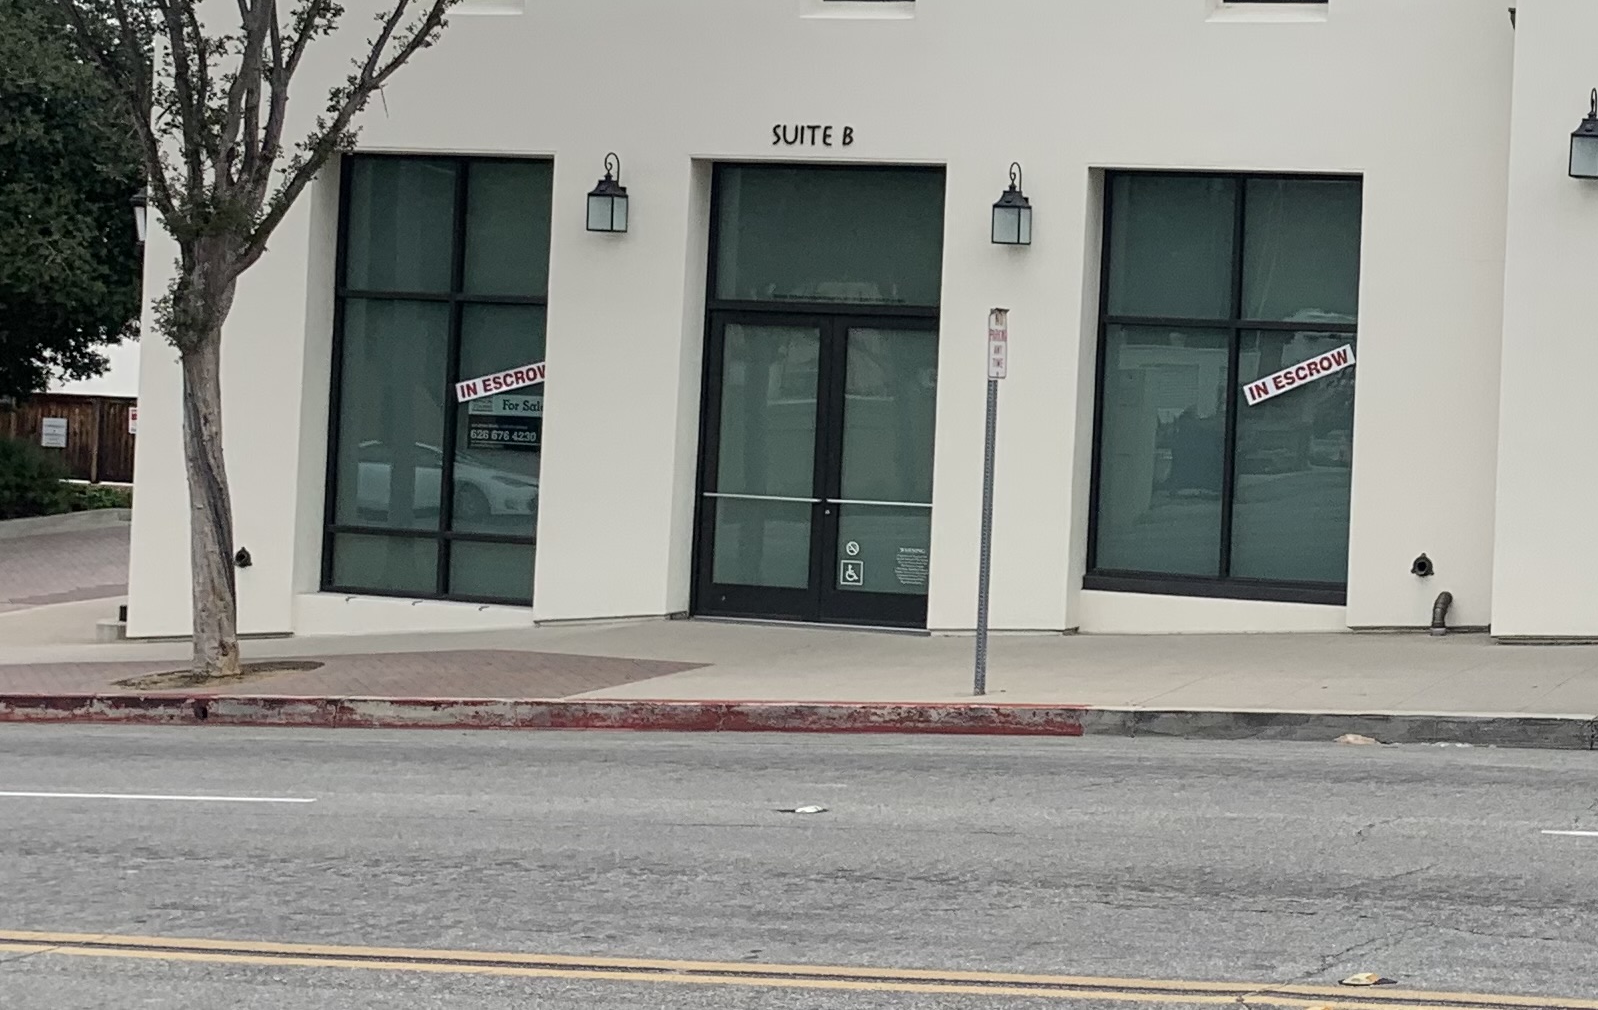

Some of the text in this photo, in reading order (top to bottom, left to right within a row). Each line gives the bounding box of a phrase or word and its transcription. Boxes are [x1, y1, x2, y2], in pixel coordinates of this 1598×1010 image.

[772, 123, 854, 146] SUITE B
[1248, 348, 1348, 401] IN ESCROW
[459, 382, 478, 399] IN
[502, 399, 521, 411] For
[470, 429, 537, 442] 626 676 4230
